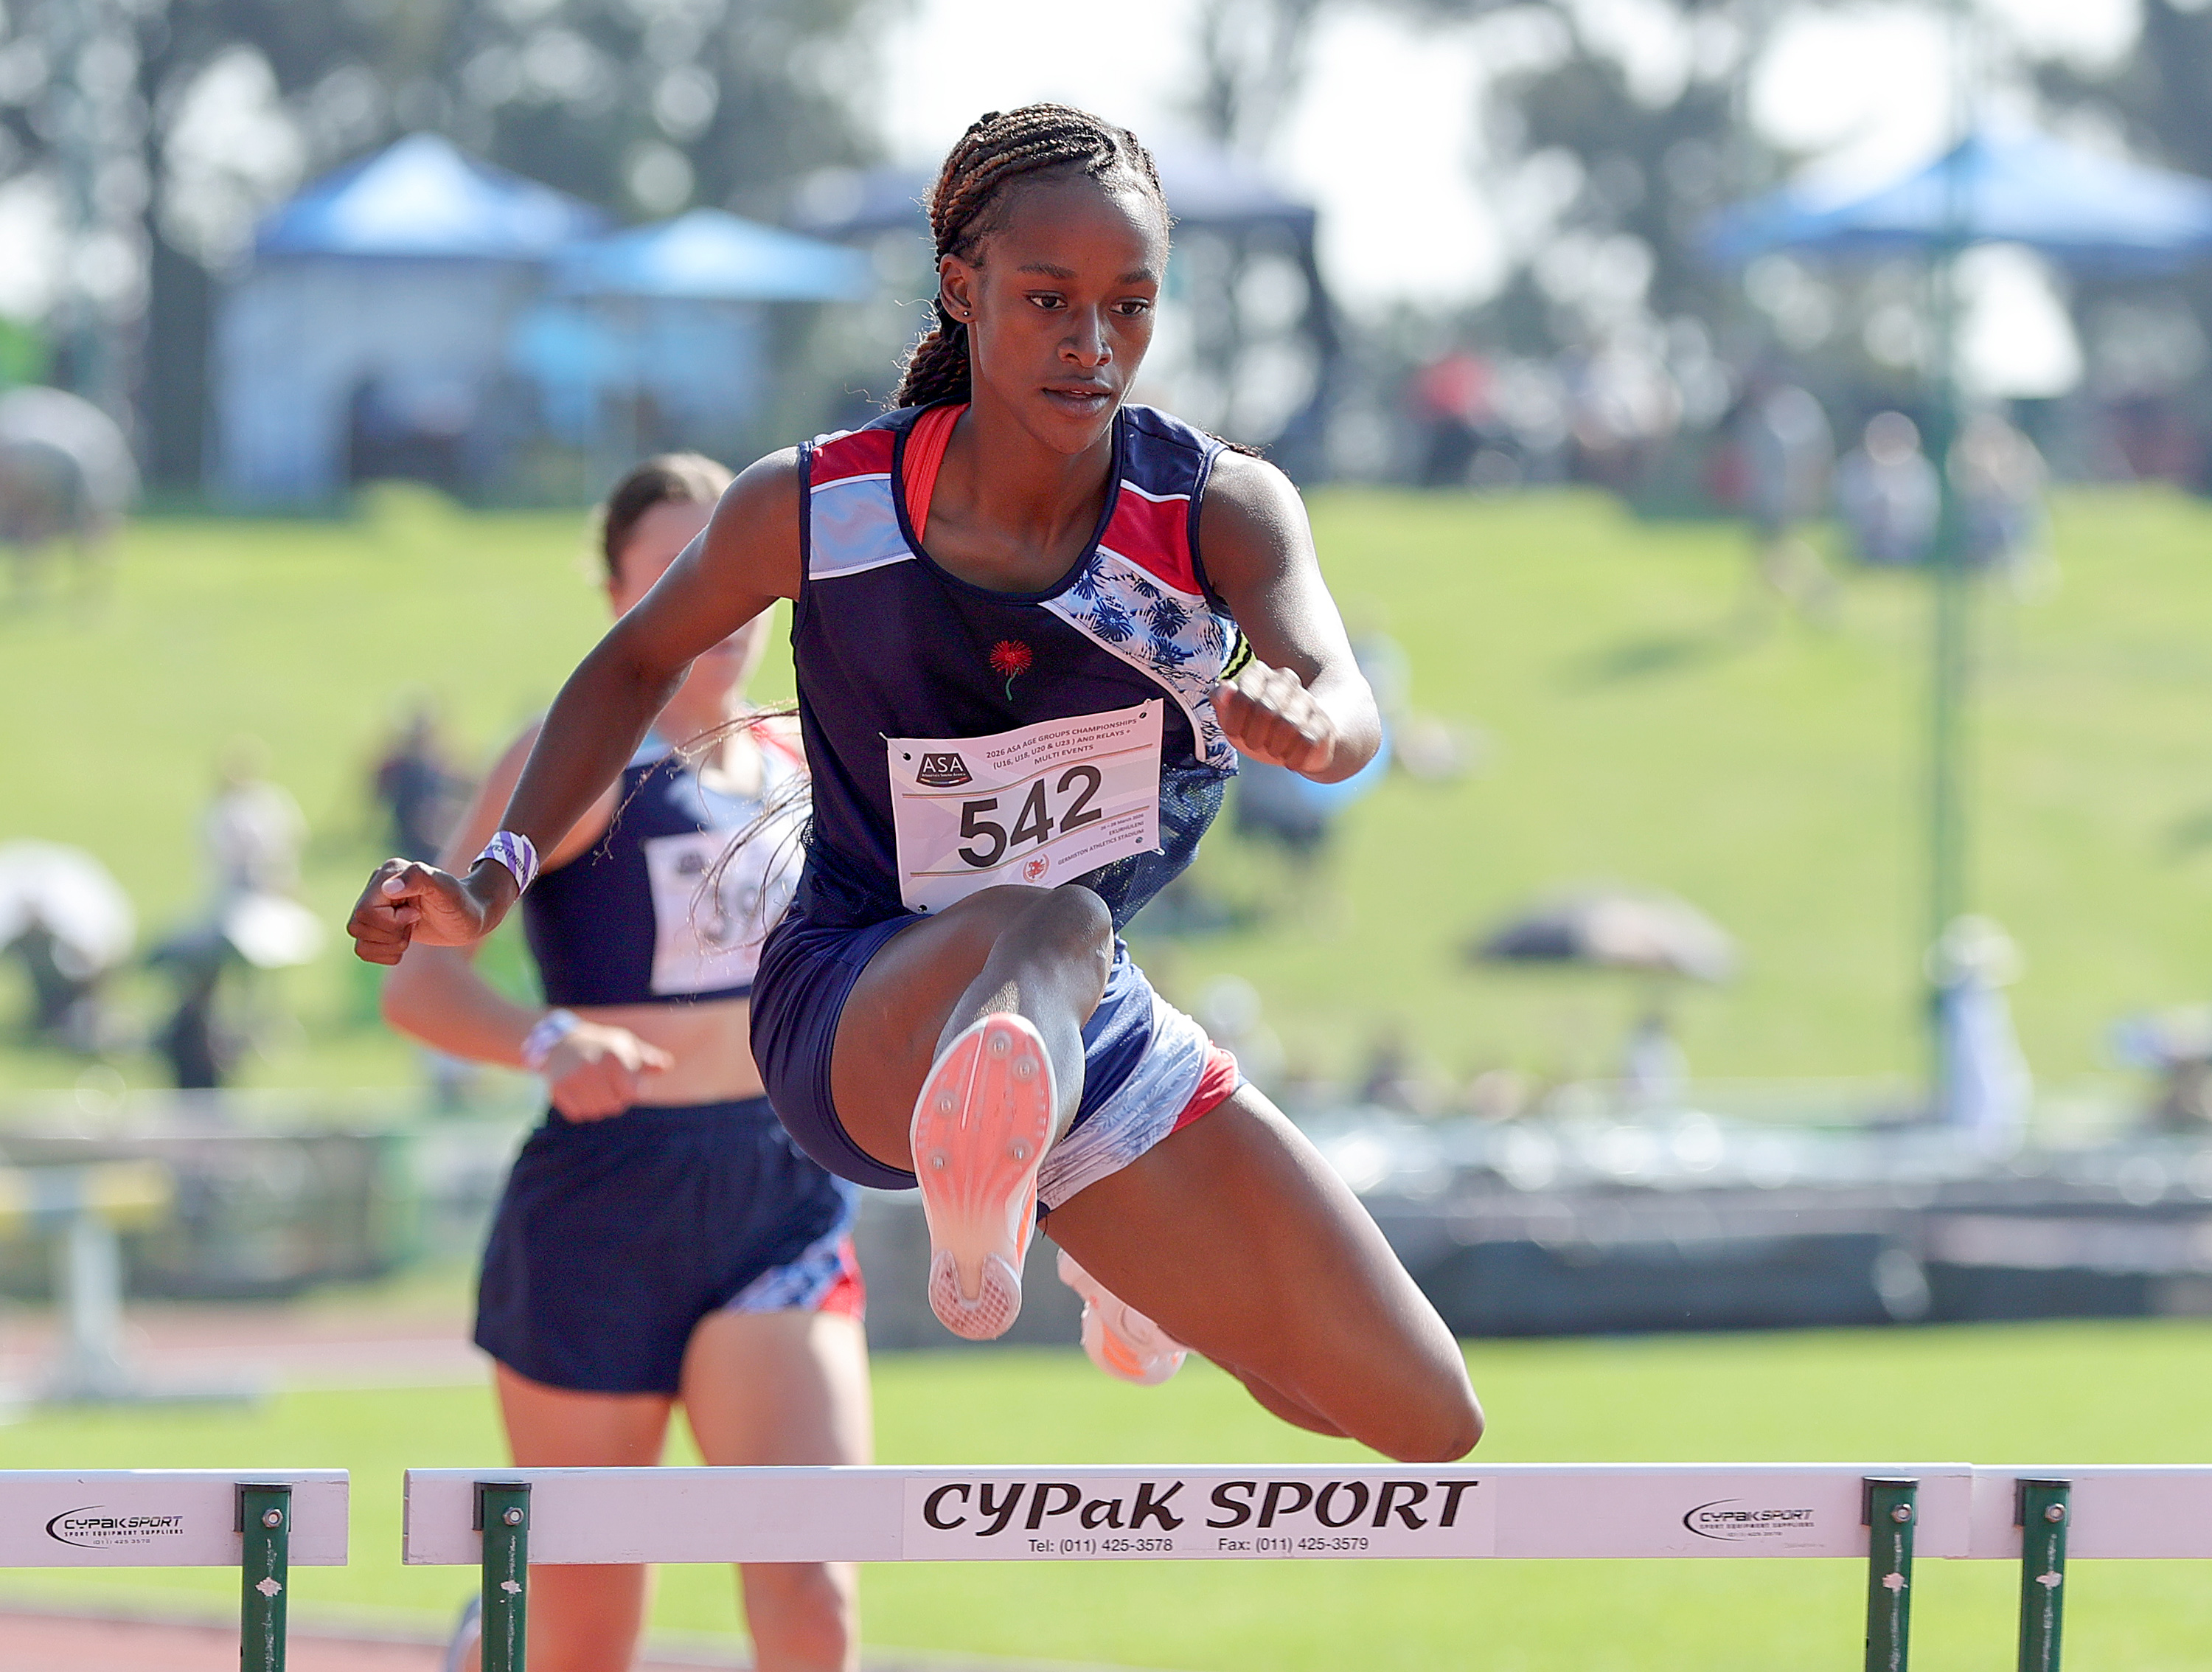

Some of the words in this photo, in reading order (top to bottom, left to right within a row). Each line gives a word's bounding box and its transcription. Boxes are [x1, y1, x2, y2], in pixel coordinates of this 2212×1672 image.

[987, 749, 1005, 758] 2026
[1007, 745, 1021, 754] ASA
[1023, 738, 1037, 748] AGE
[1038, 730, 1070, 741] GROUPS
[1072, 719, 1137, 735] CHAMPIONSHIPS
[993, 759, 1013, 769] (U16,
[1015, 752, 1030, 762] U18,
[1032, 746, 1045, 755] U20
[1096, 730, 1124, 740] RELAYS
[1034, 752, 1059, 765] MULTI
[1062, 745, 1093, 755] EVENTS
[923, 757, 964, 772] ASA
[959, 765, 1102, 867] 542
[1058, 847, 1088, 865] GERMISTON
[1089, 838, 1116, 851] ATHLETICS
[1118, 829, 1144, 841] STADIUM
[1206, 1481, 1478, 1530] SPORT
[1028, 1539, 1054, 1552] Tel:
[1060, 1539, 1096, 1555] (011)
[1102, 1539, 1173, 1551] 425-3578
[1218, 1539, 1251, 1550] Fax:
[1256, 1537, 1293, 1553] (011)
[1298, 1538, 1368, 1550] 425-3579
